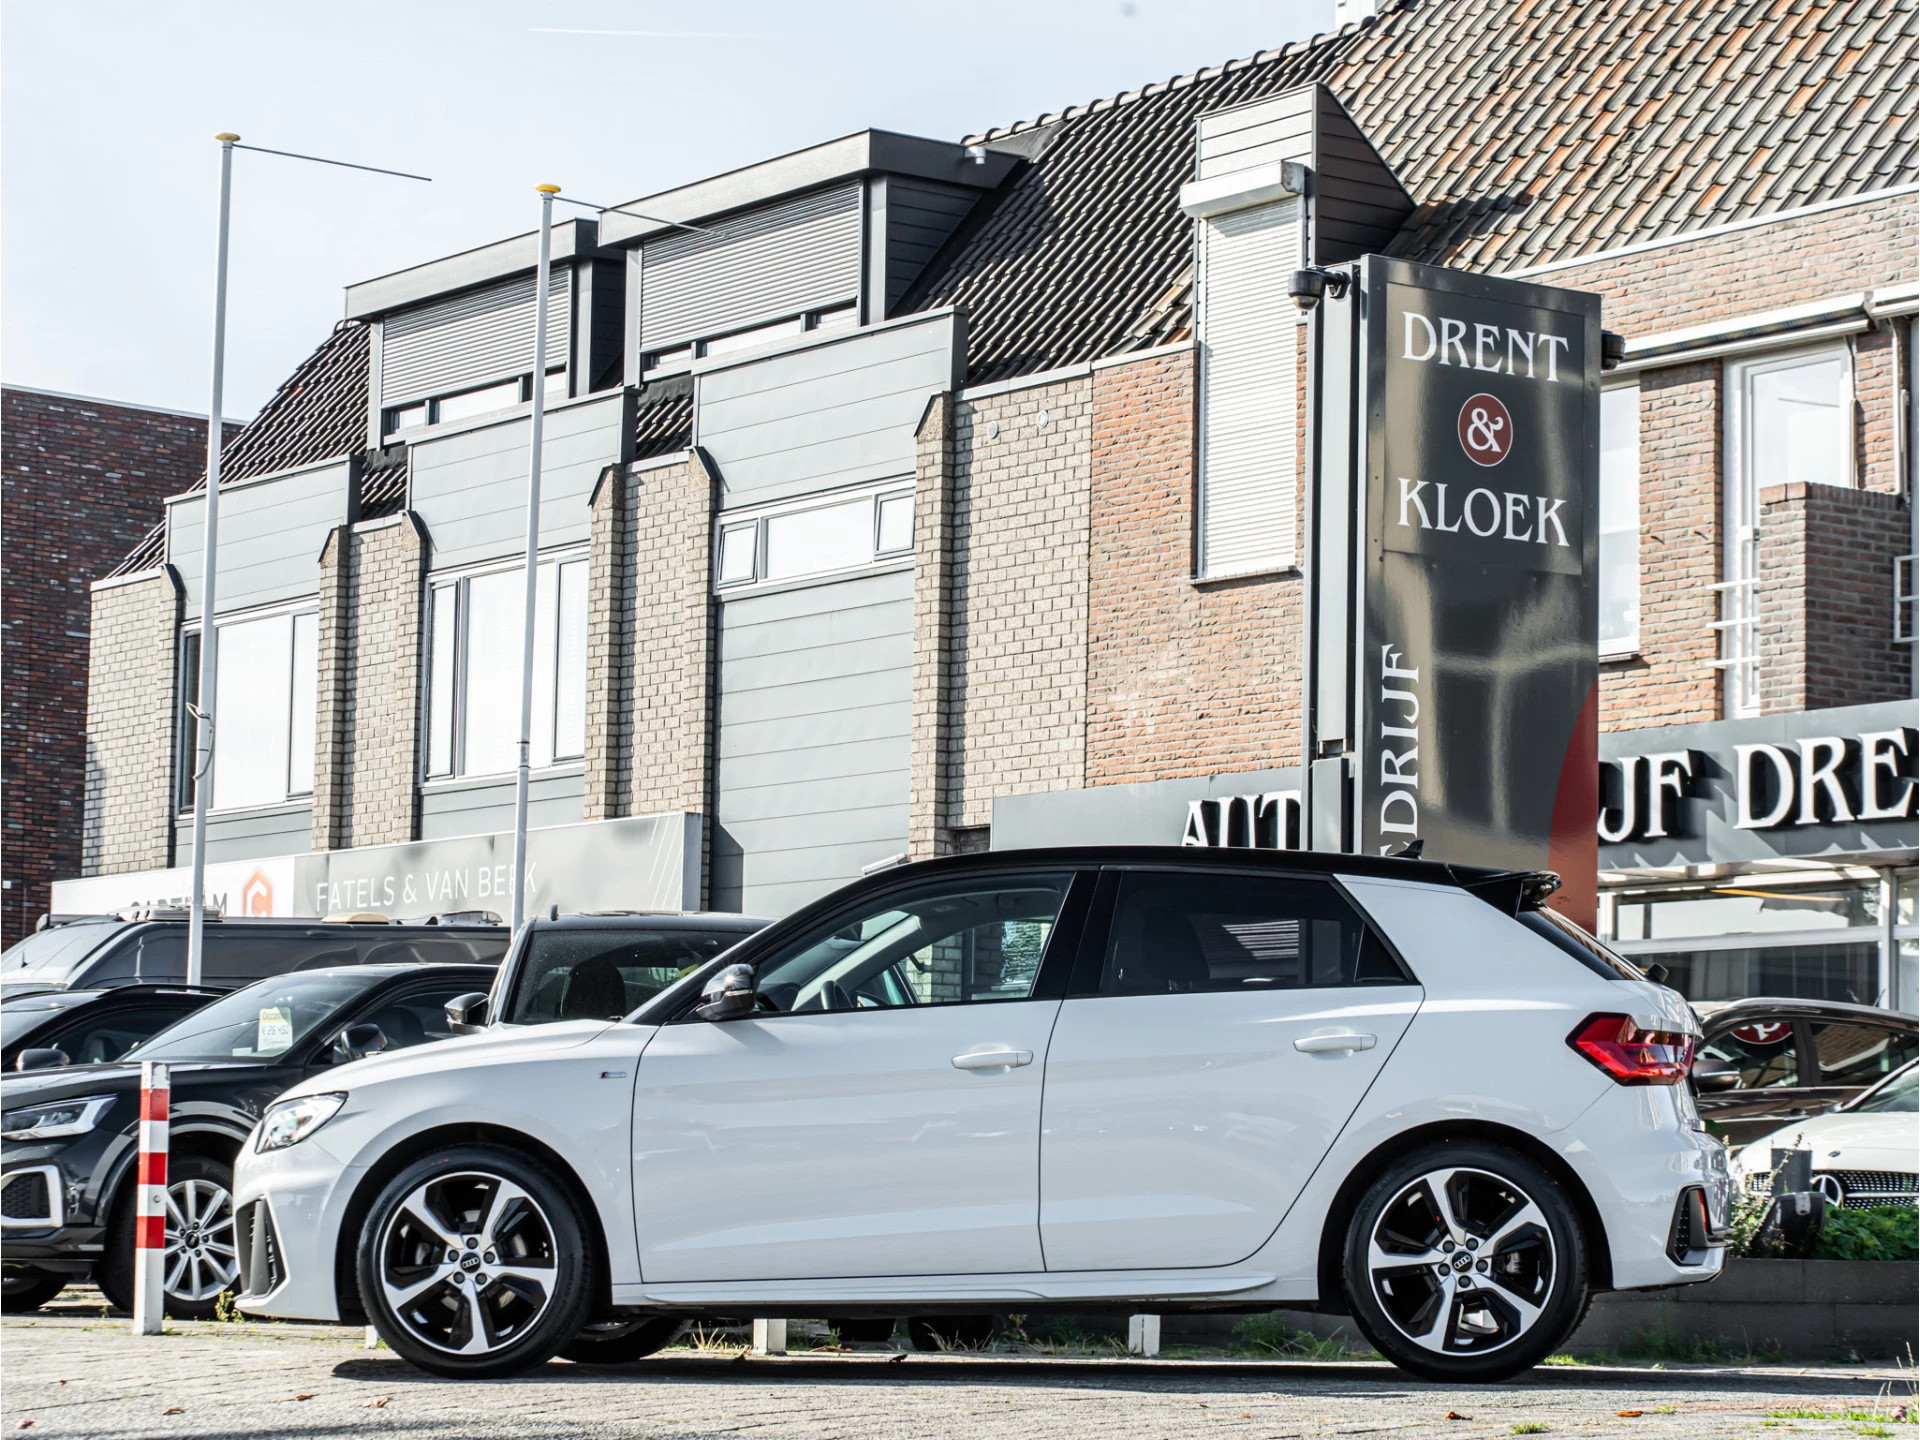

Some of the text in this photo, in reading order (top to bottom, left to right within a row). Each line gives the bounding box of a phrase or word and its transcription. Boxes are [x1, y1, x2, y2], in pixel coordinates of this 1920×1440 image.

[1402, 311, 1569, 382] DRENT
[1467, 408, 1504, 453] &
[1397, 478, 1570, 547] KLOEK
[1380, 643, 1420, 857] DRIJF
[1733, 728, 1920, 830] DRE
[316, 876, 395, 912] FATELS
[403, 874, 418, 904] &
[426, 868, 469, 899] VAN
